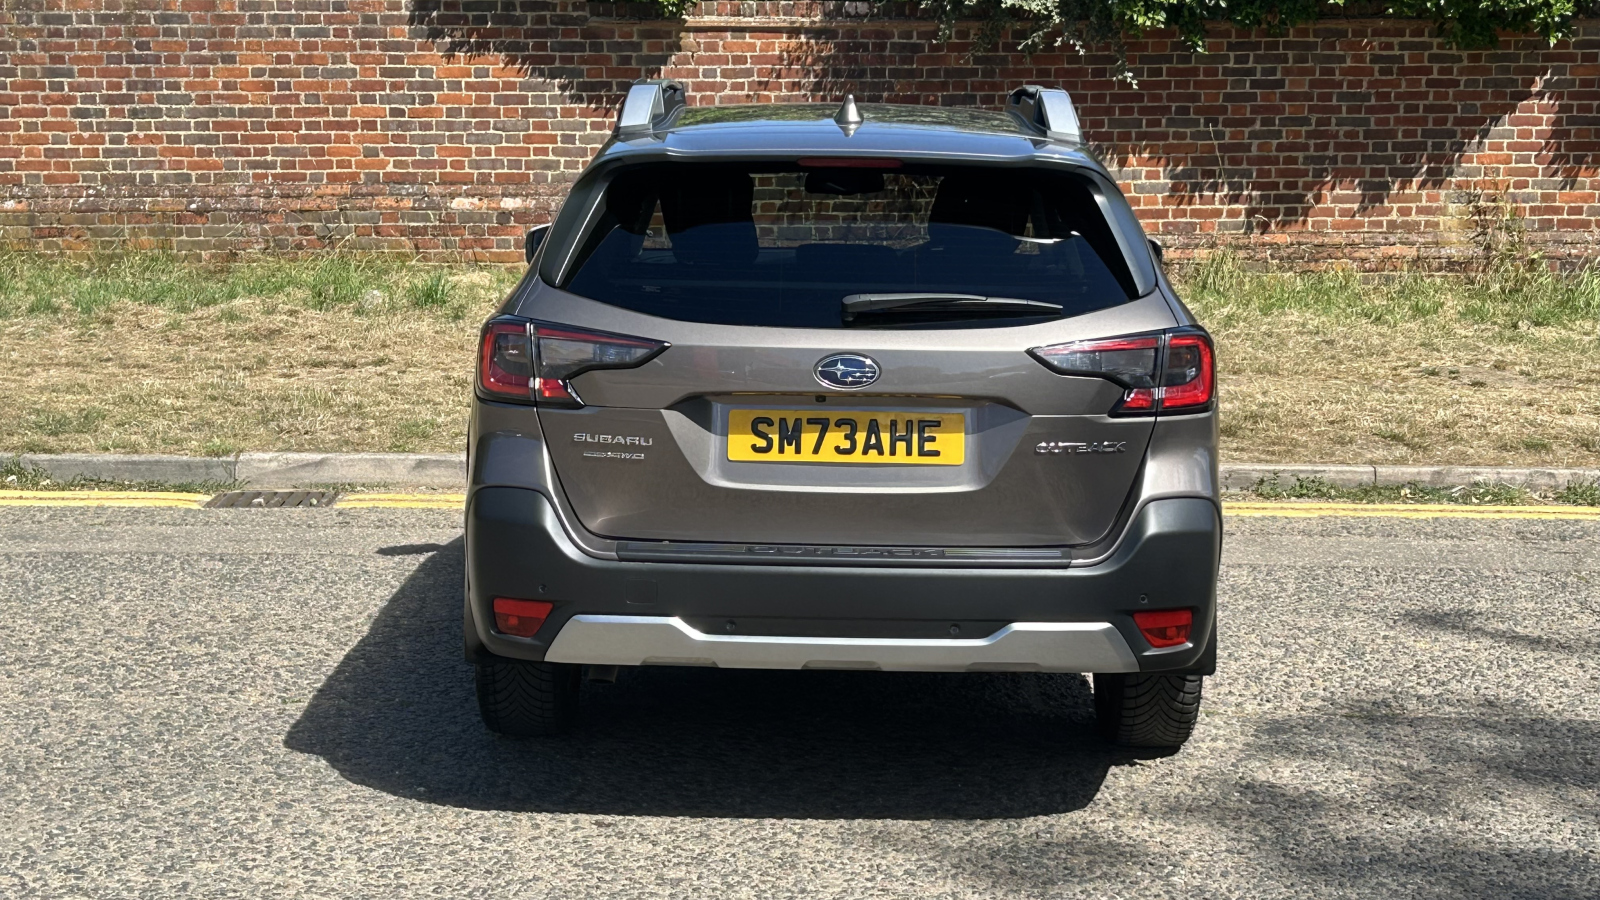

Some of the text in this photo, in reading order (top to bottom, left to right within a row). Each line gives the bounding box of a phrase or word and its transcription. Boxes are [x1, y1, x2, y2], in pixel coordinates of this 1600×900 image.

[573, 433, 653, 446] SUBARU
[750, 416, 942, 457] SM73AHE
[1035, 441, 1127, 454] OUTBACK
